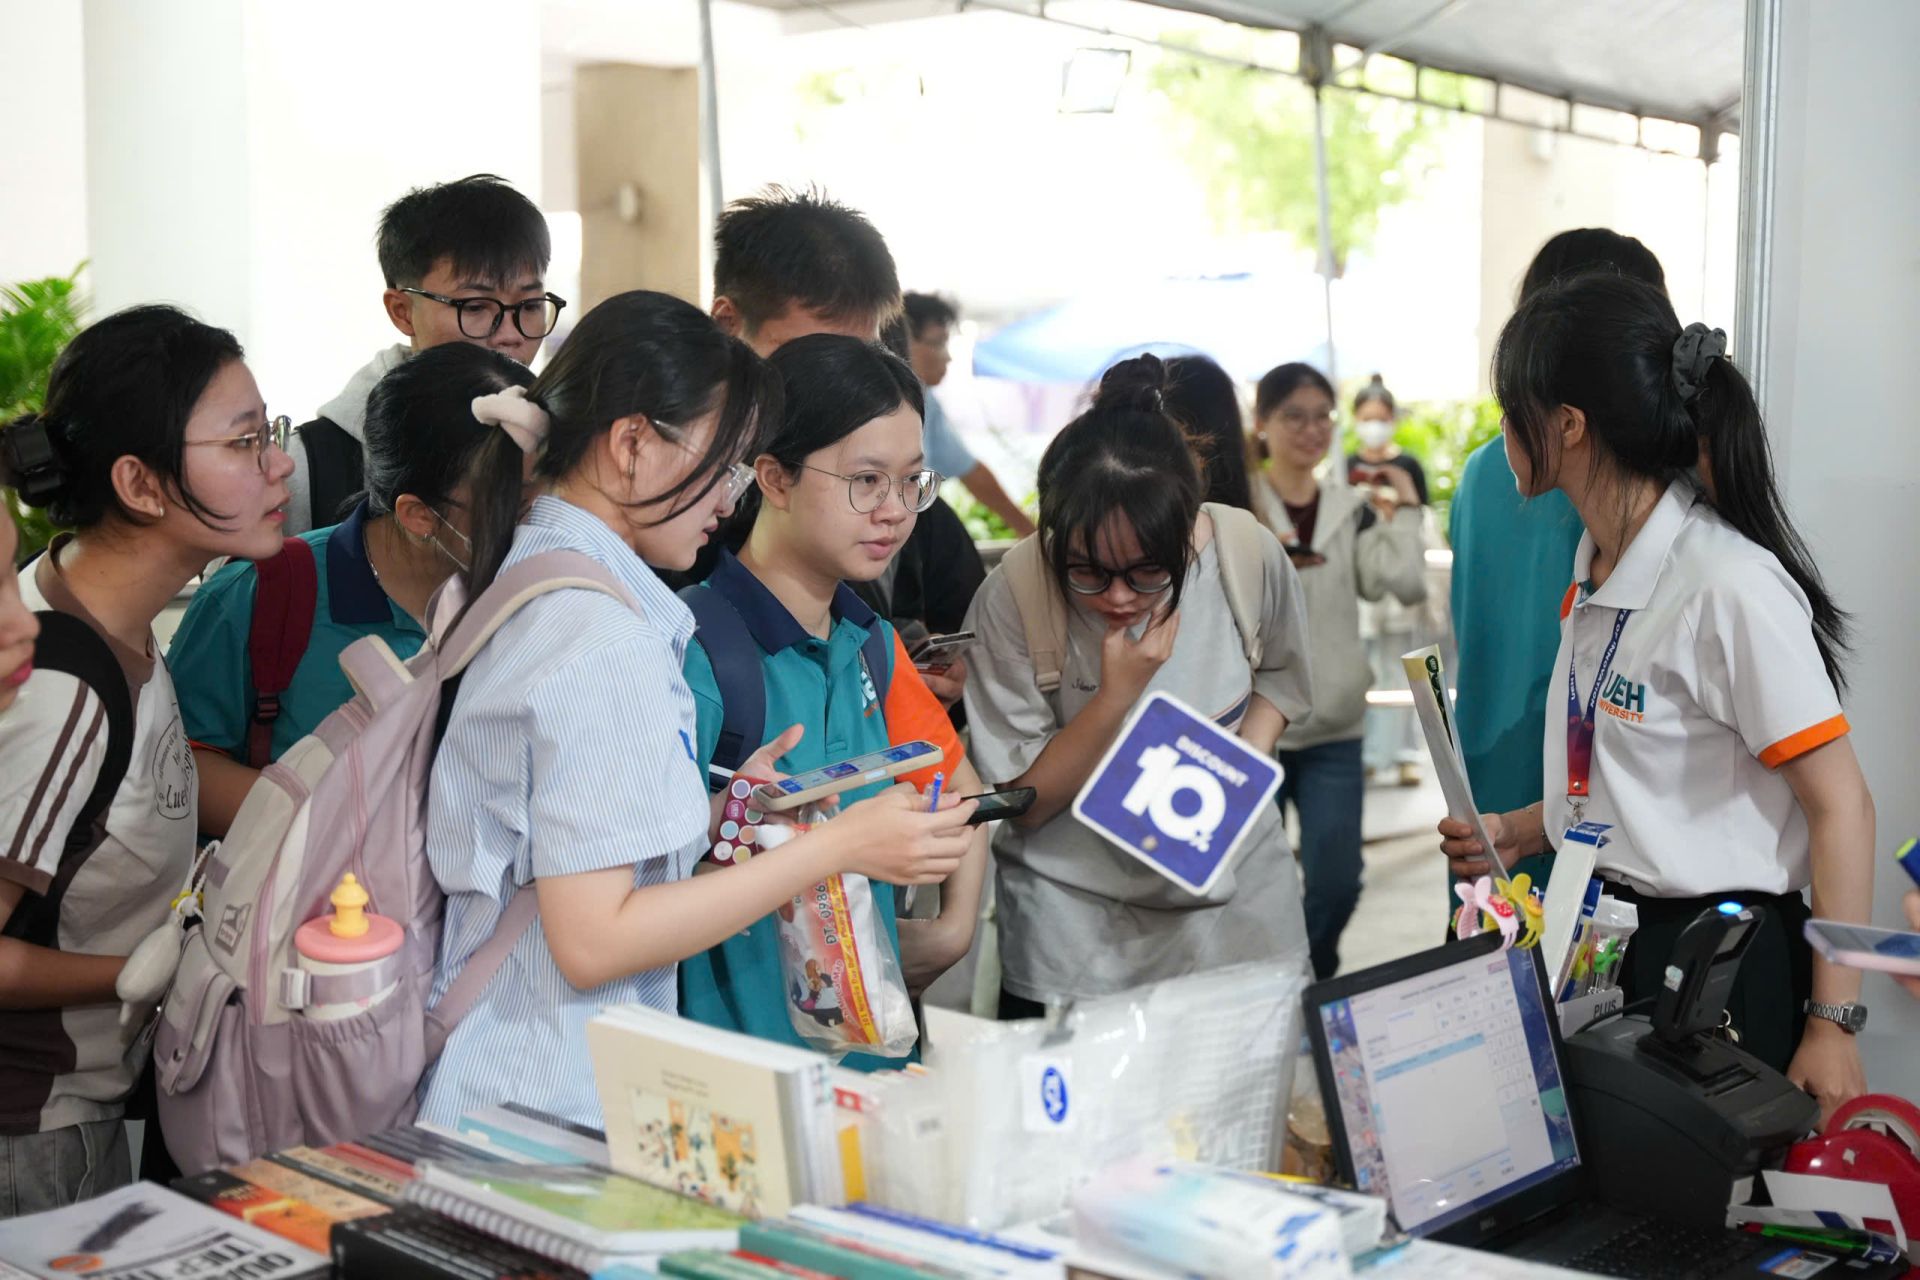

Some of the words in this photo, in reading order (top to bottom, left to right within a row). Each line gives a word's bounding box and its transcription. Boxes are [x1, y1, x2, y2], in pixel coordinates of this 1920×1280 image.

[1590, 641, 1617, 708] INNOVATION
[1602, 670, 1645, 713] UEH
[1598, 698, 1644, 723] NIVERSITY
[1175, 734, 1249, 788] DISCOUNT
